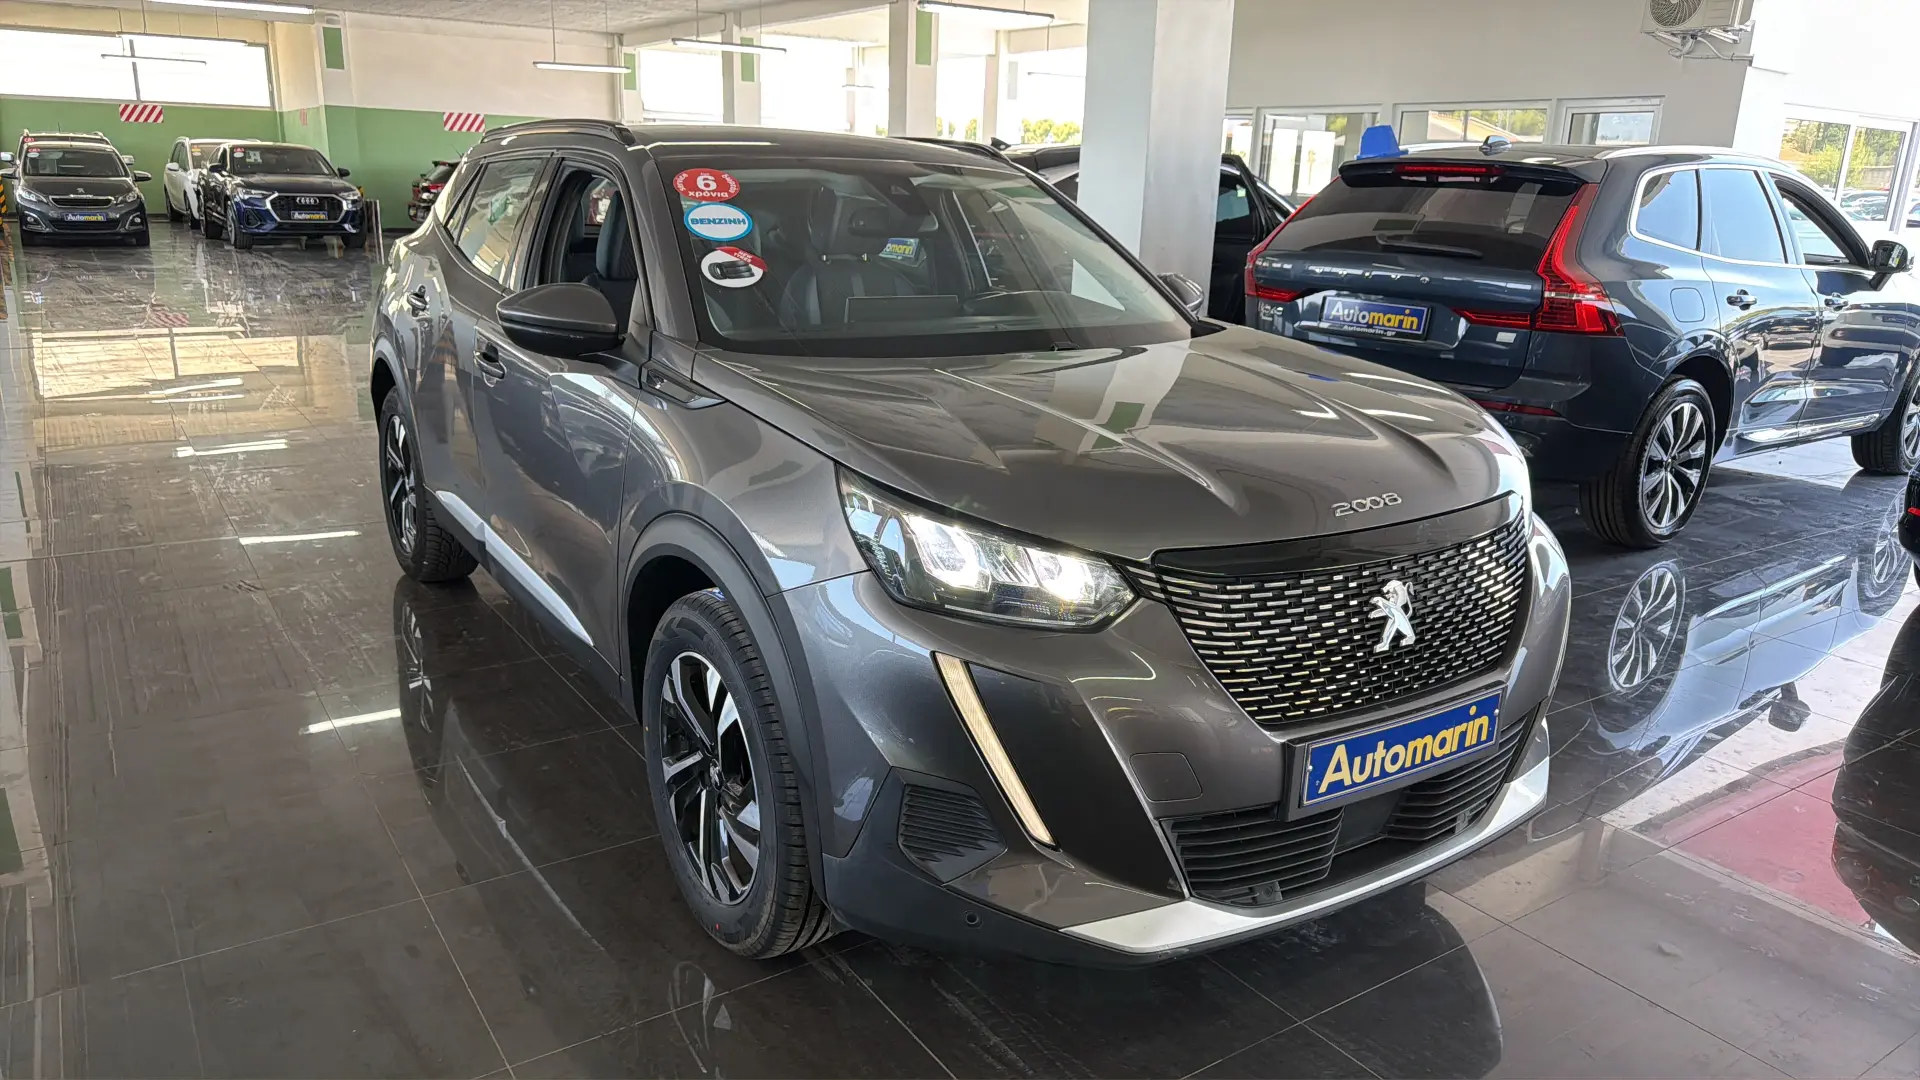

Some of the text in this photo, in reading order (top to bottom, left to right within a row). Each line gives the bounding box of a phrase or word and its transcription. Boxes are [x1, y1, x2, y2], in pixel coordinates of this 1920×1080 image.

[696, 175, 717, 191] 6
[688, 190, 729, 198] χρόνια
[67, 213, 104, 221] Automarin
[1329, 301, 1419, 330] Automarin
[1342, 325, 1397, 337] Automarin.gr
[1331, 492, 1402, 517] 2008
[1318, 705, 1489, 794] Automarin
